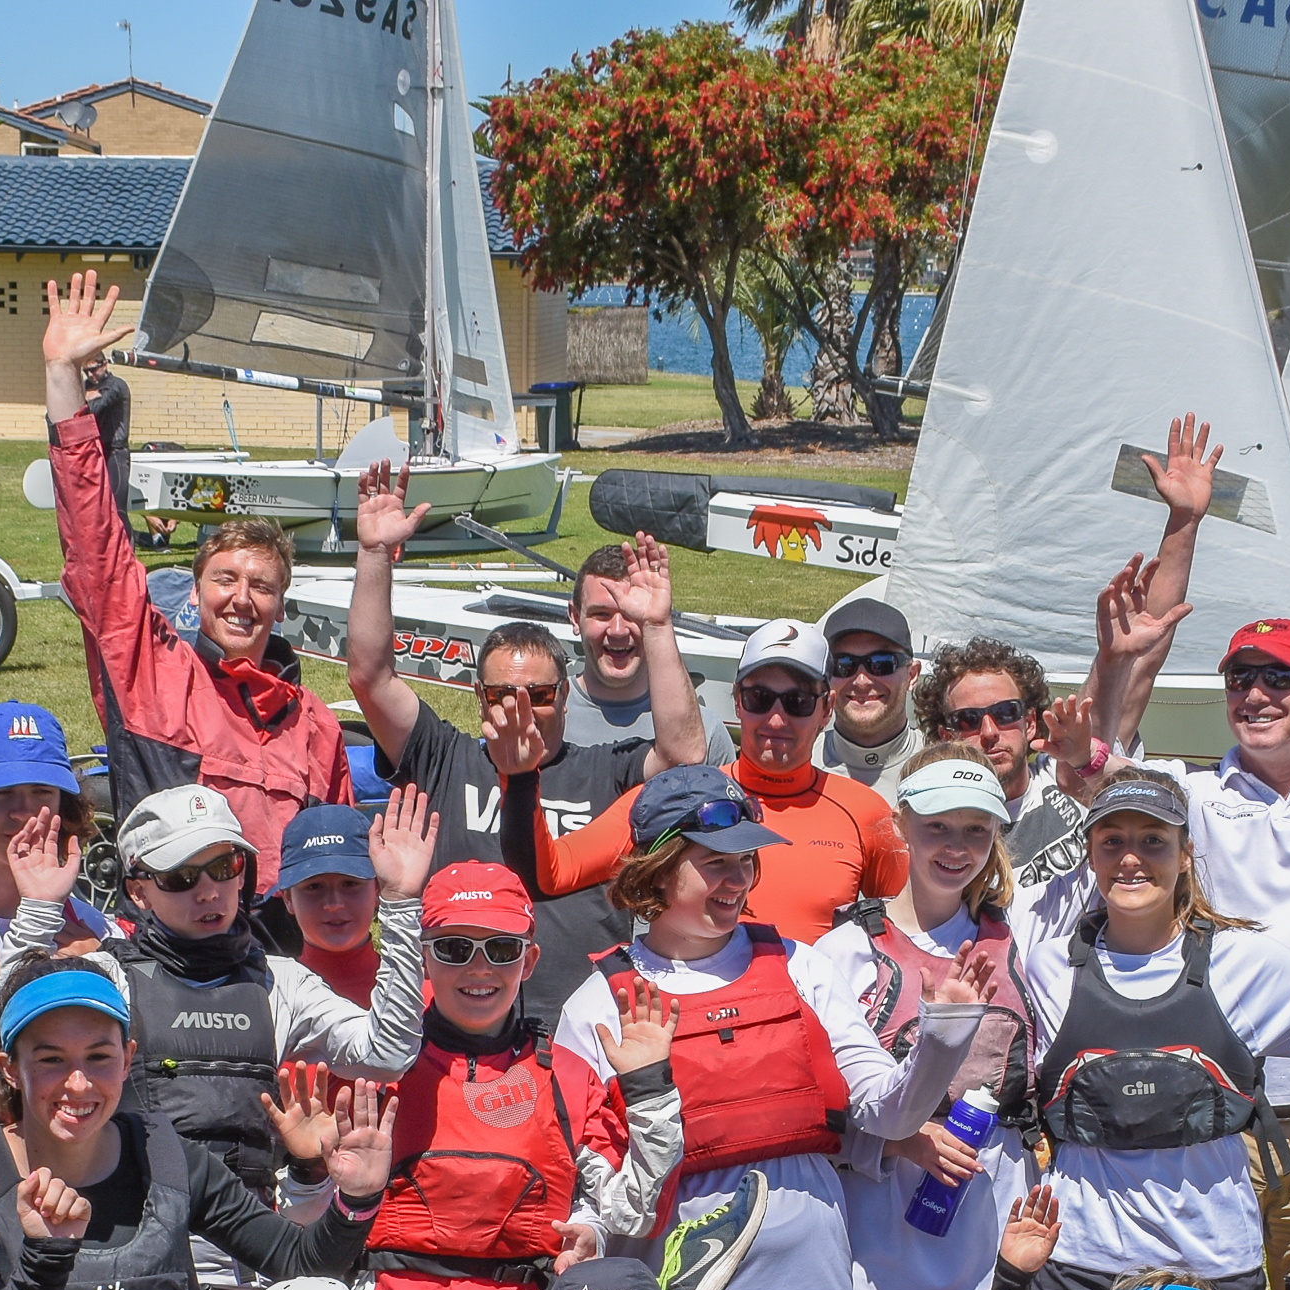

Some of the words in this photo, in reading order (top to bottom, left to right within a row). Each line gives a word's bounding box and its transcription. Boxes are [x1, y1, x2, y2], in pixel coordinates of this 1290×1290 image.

[239, 493, 257, 503] BEER
[1106, 785, 1159, 801] Falcons
[303, 834, 345, 849] MUSTO
[808, 840, 845, 850] MUSTO
[448, 890, 493, 901] MUSTO
[171, 1011, 251, 1031] MUSTO
[1122, 1081, 1156, 1096] Gill
[473, 1083, 534, 1112] Gill
[922, 1197, 947, 1214] College
